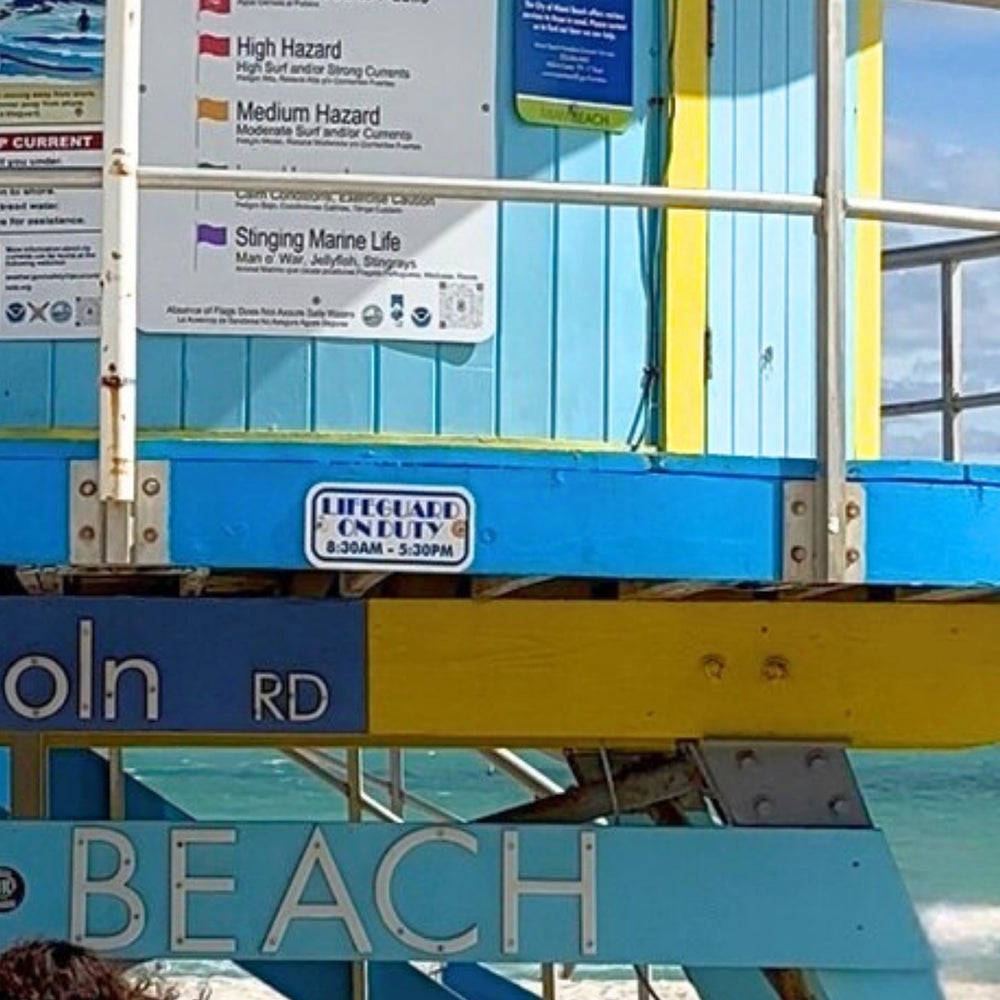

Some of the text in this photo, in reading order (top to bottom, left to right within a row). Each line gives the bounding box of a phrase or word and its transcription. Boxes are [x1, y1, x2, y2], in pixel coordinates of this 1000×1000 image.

[237, 36, 342, 61] High Hazard
[236, 61, 262, 74] High
[264, 61, 288, 73] Surf
[327, 63, 363, 79] Strong
[365, 65, 410, 79] Currents
[236, 100, 380, 126] Medium Hazard
[12, 135, 93, 149] CURRENT
[236, 124, 292, 136] Moderate
[295, 125, 321, 137] Surf
[362, 127, 413, 141] Currents
[235, 226, 401, 253] Stinging Marine Life
[235, 252, 262, 264] Man
[363, 255, 417, 271] Stingrays
[322, 497, 461, 519] LIFEGUARD
[338, 518, 445, 540] ON DUTY
[326, 540, 383, 554] 8:30AM
[397, 543, 453, 557] 5:30PM
[253, 671, 330, 722] RD
[70, 824, 598, 957] BEACH
